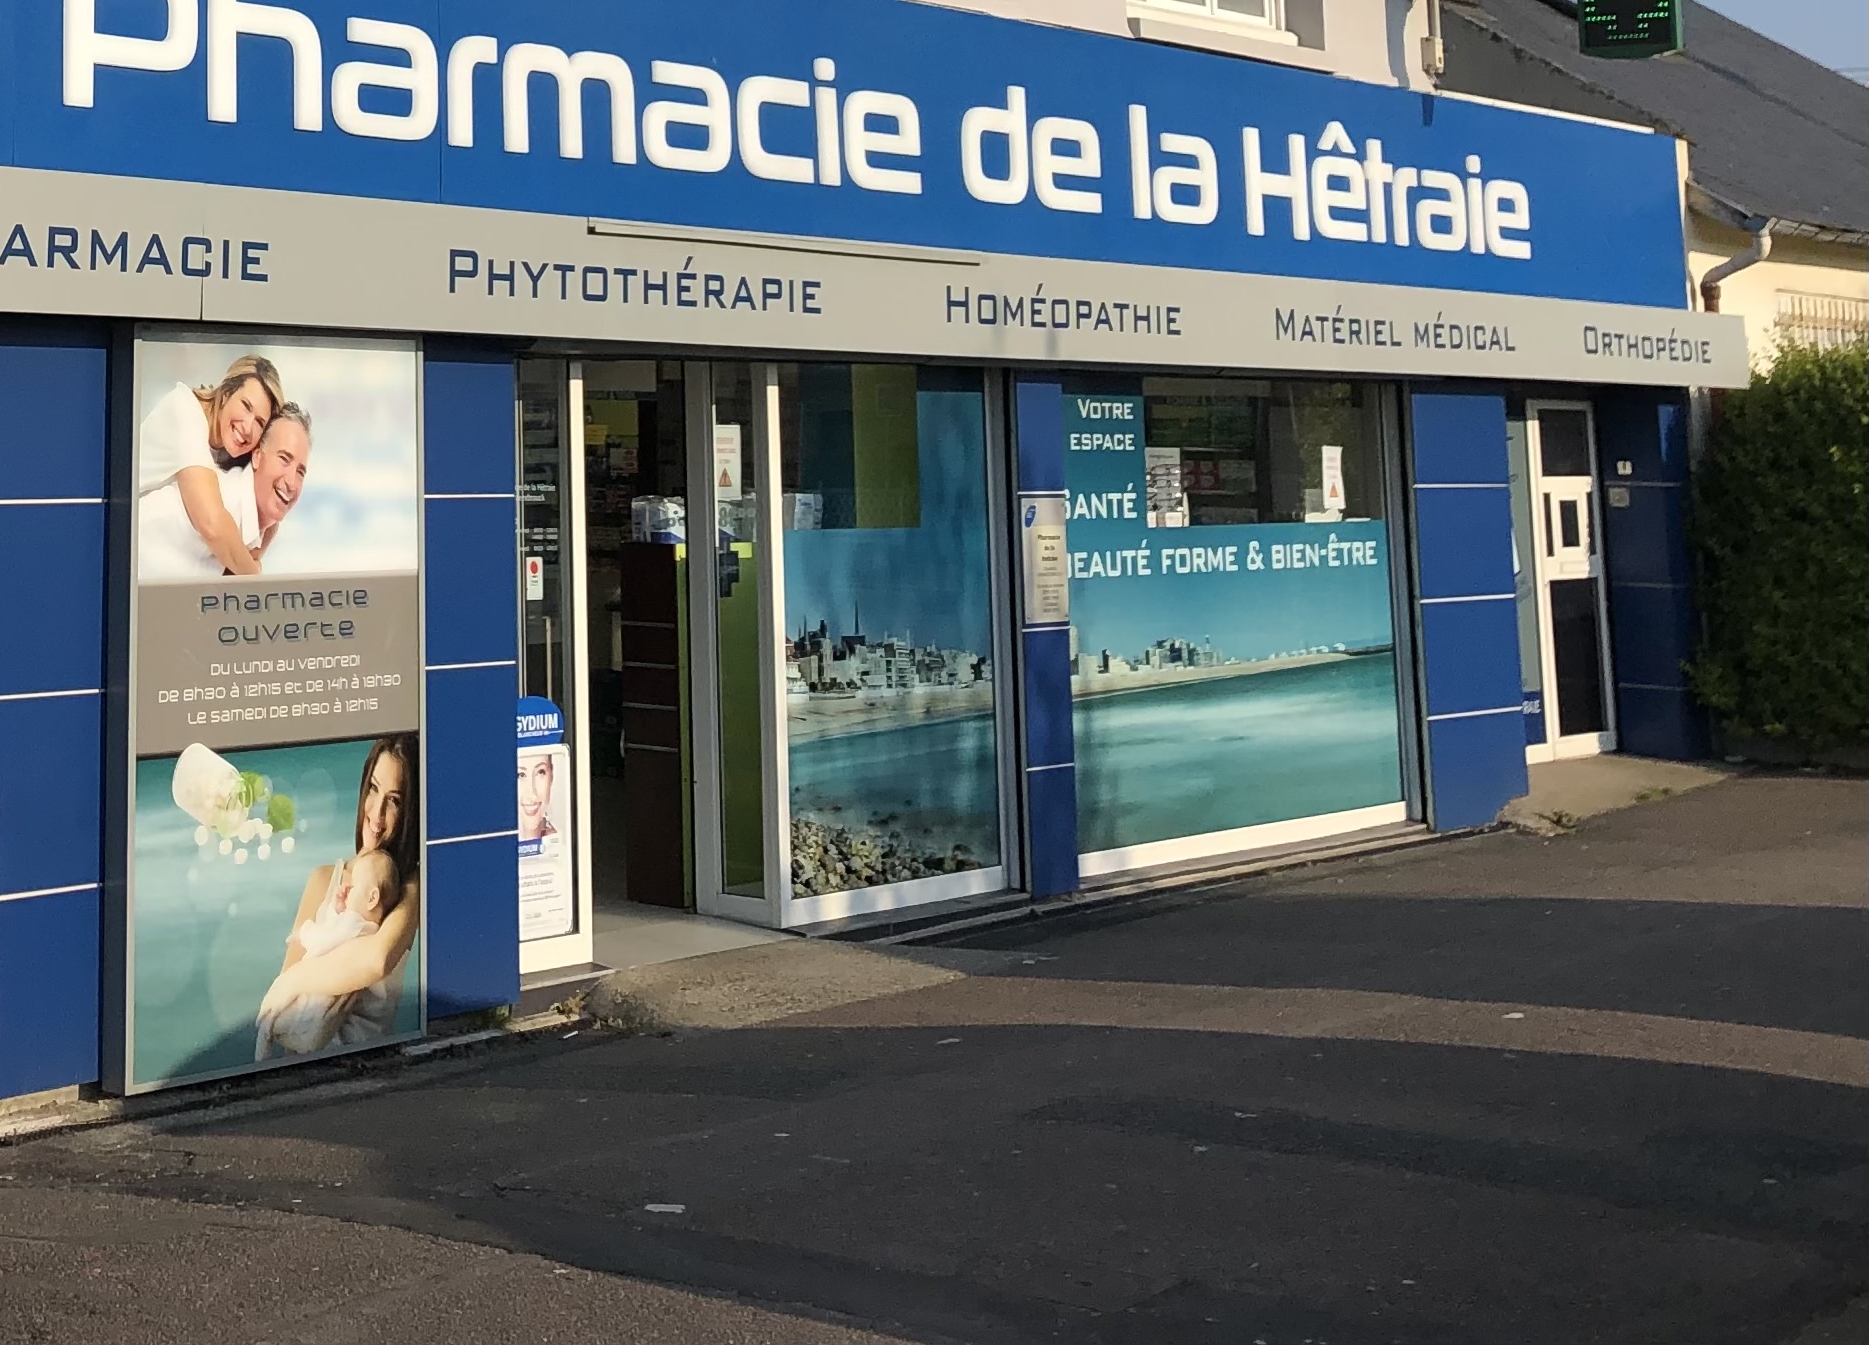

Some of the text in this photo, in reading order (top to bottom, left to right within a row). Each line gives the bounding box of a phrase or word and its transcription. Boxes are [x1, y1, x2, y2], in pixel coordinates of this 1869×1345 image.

[961, 85, 1103, 215] de
[1129, 103, 1220, 226] la
[1242, 120, 1532, 259] Hêtraie
[448, 248, 823, 315] PHYTOTHÉRAPIE
[946, 282, 1182, 336] HOMÉOPATHIE
[1274, 304, 1403, 347] MATÉRIEL
[1413, 311, 1517, 352] MÉDICAL
[1583, 324, 1713, 364] ORTHOPÉDIE
[1077, 398, 1134, 420] VOTRE
[1070, 433, 1135, 451] ESPACE
[1161, 544, 1239, 575] FORME
[1247, 540, 1265, 570] &
[1271, 532, 1378, 569] BIEN-ÊTRE
[200, 588, 370, 614] Pharmacie
[218, 619, 356, 644] Ouverte
[243, 681, 281, 696] 12h15
[345, 697, 379, 712] 12h15
